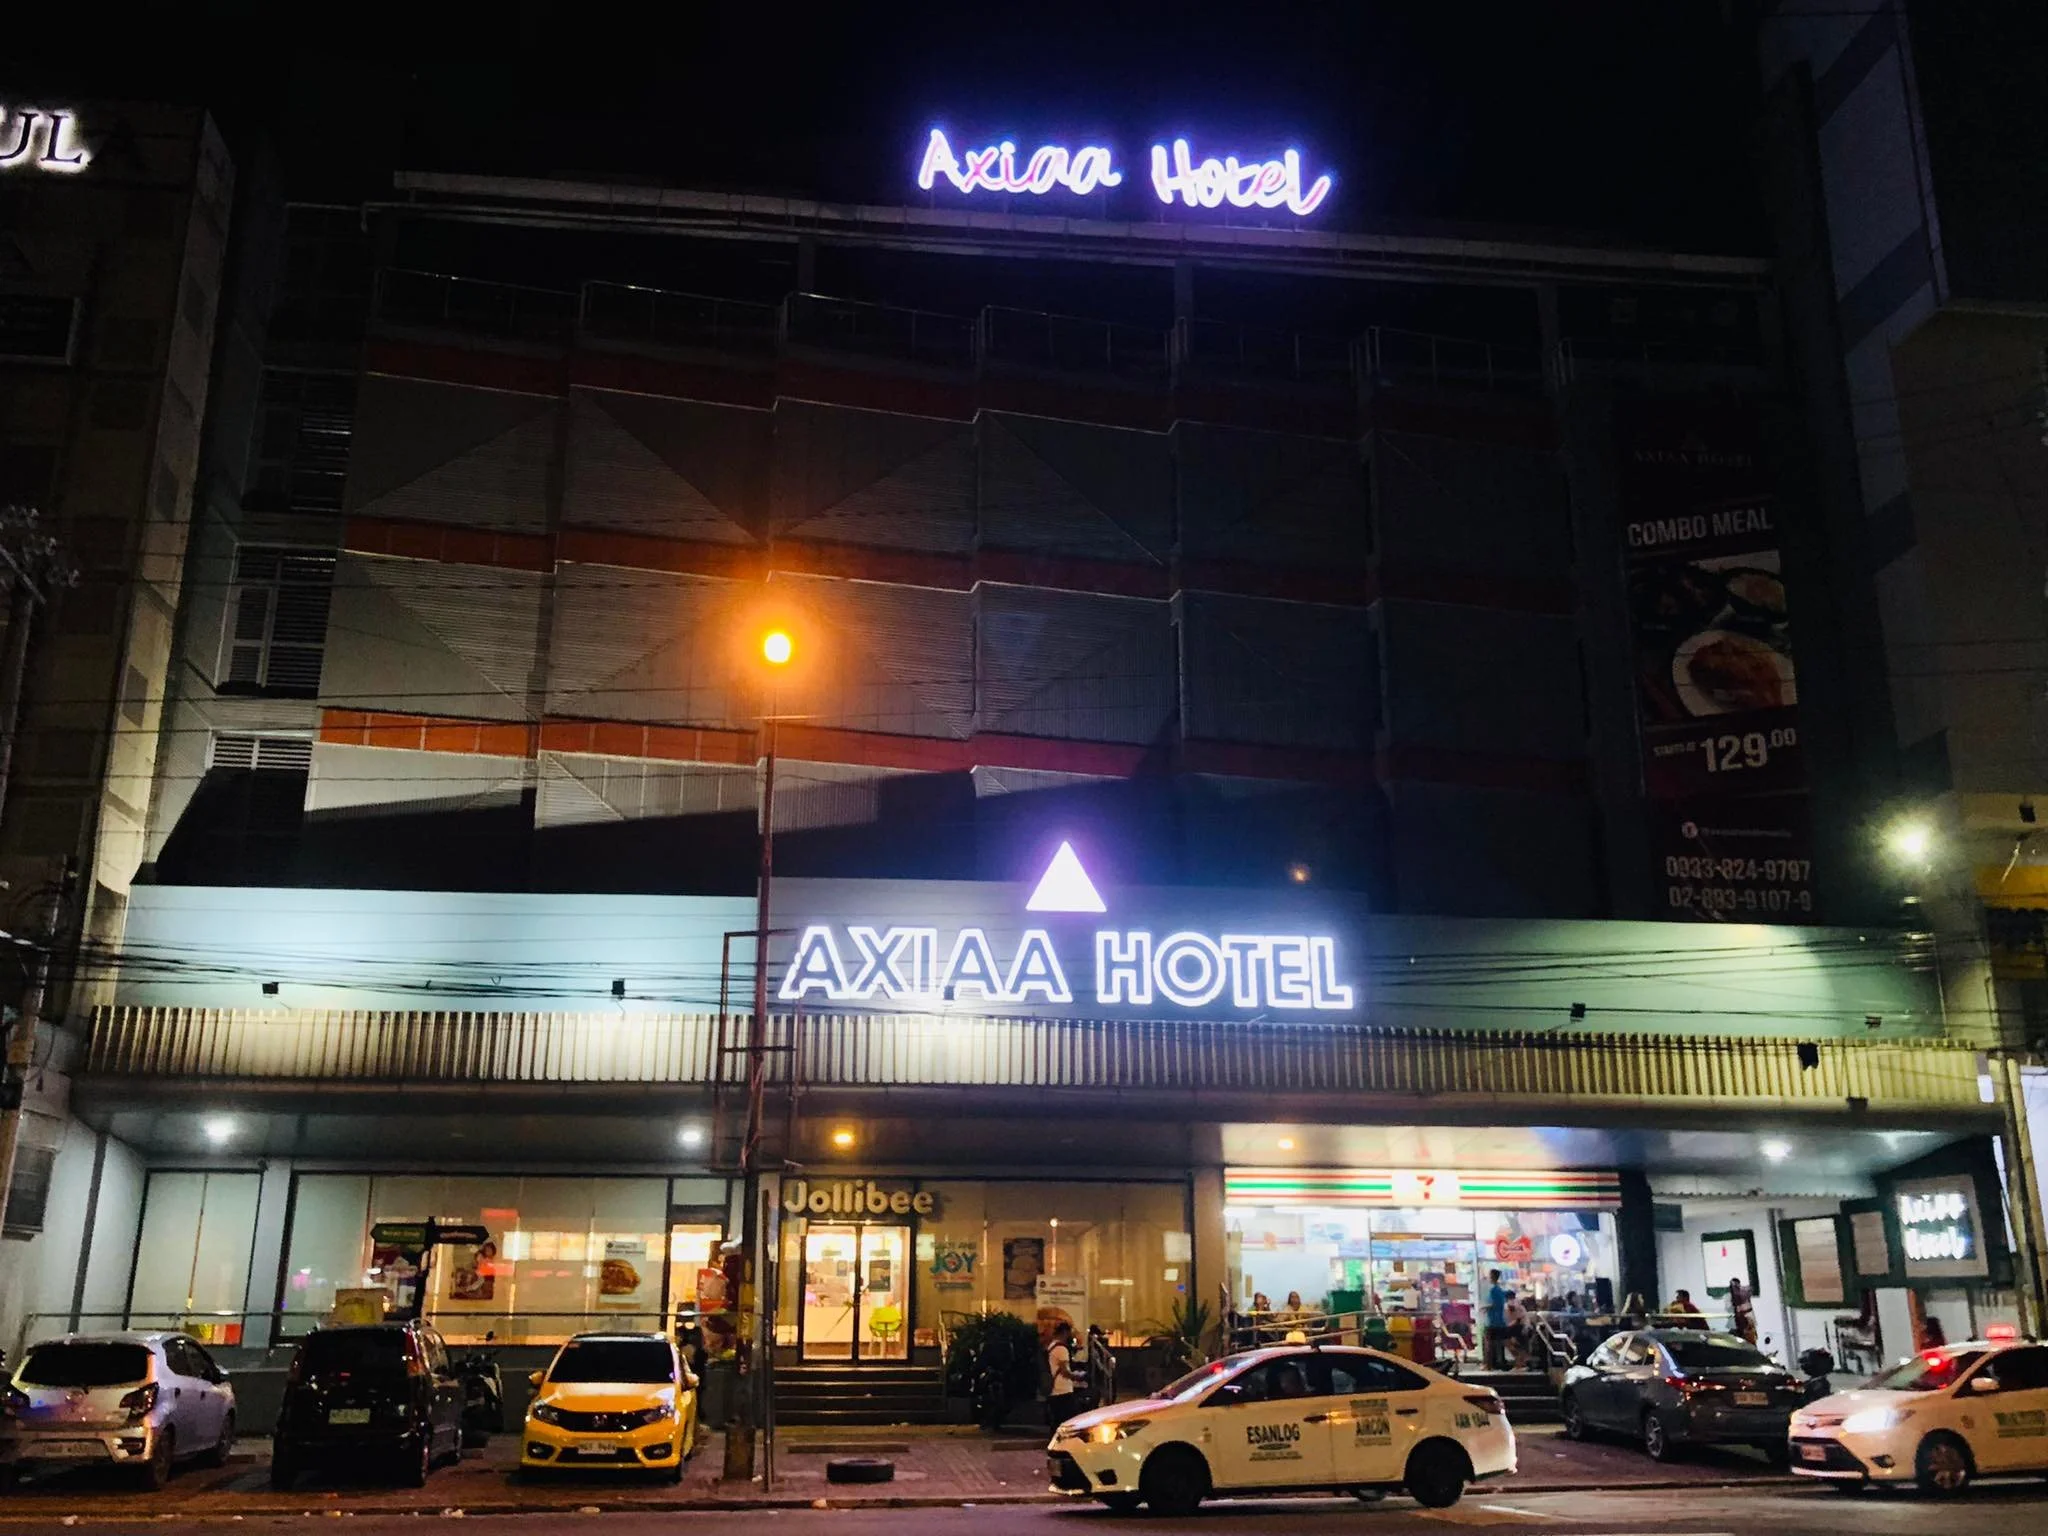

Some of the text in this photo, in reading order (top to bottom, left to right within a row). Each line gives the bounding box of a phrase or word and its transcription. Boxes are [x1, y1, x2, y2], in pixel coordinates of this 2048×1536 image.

[917, 129, 1331, 215] Axiaa Hotel
[1627, 506, 1775, 547] COMBO MEAL
[778, 925, 1354, 1009] AXIAA HOTEL
[784, 1178, 934, 1215] Jollibee
[1415, 1175, 1435, 1200] 7
[929, 1251, 977, 1275] JOY
[1246, 1423, 1301, 1444] ESANLOG
